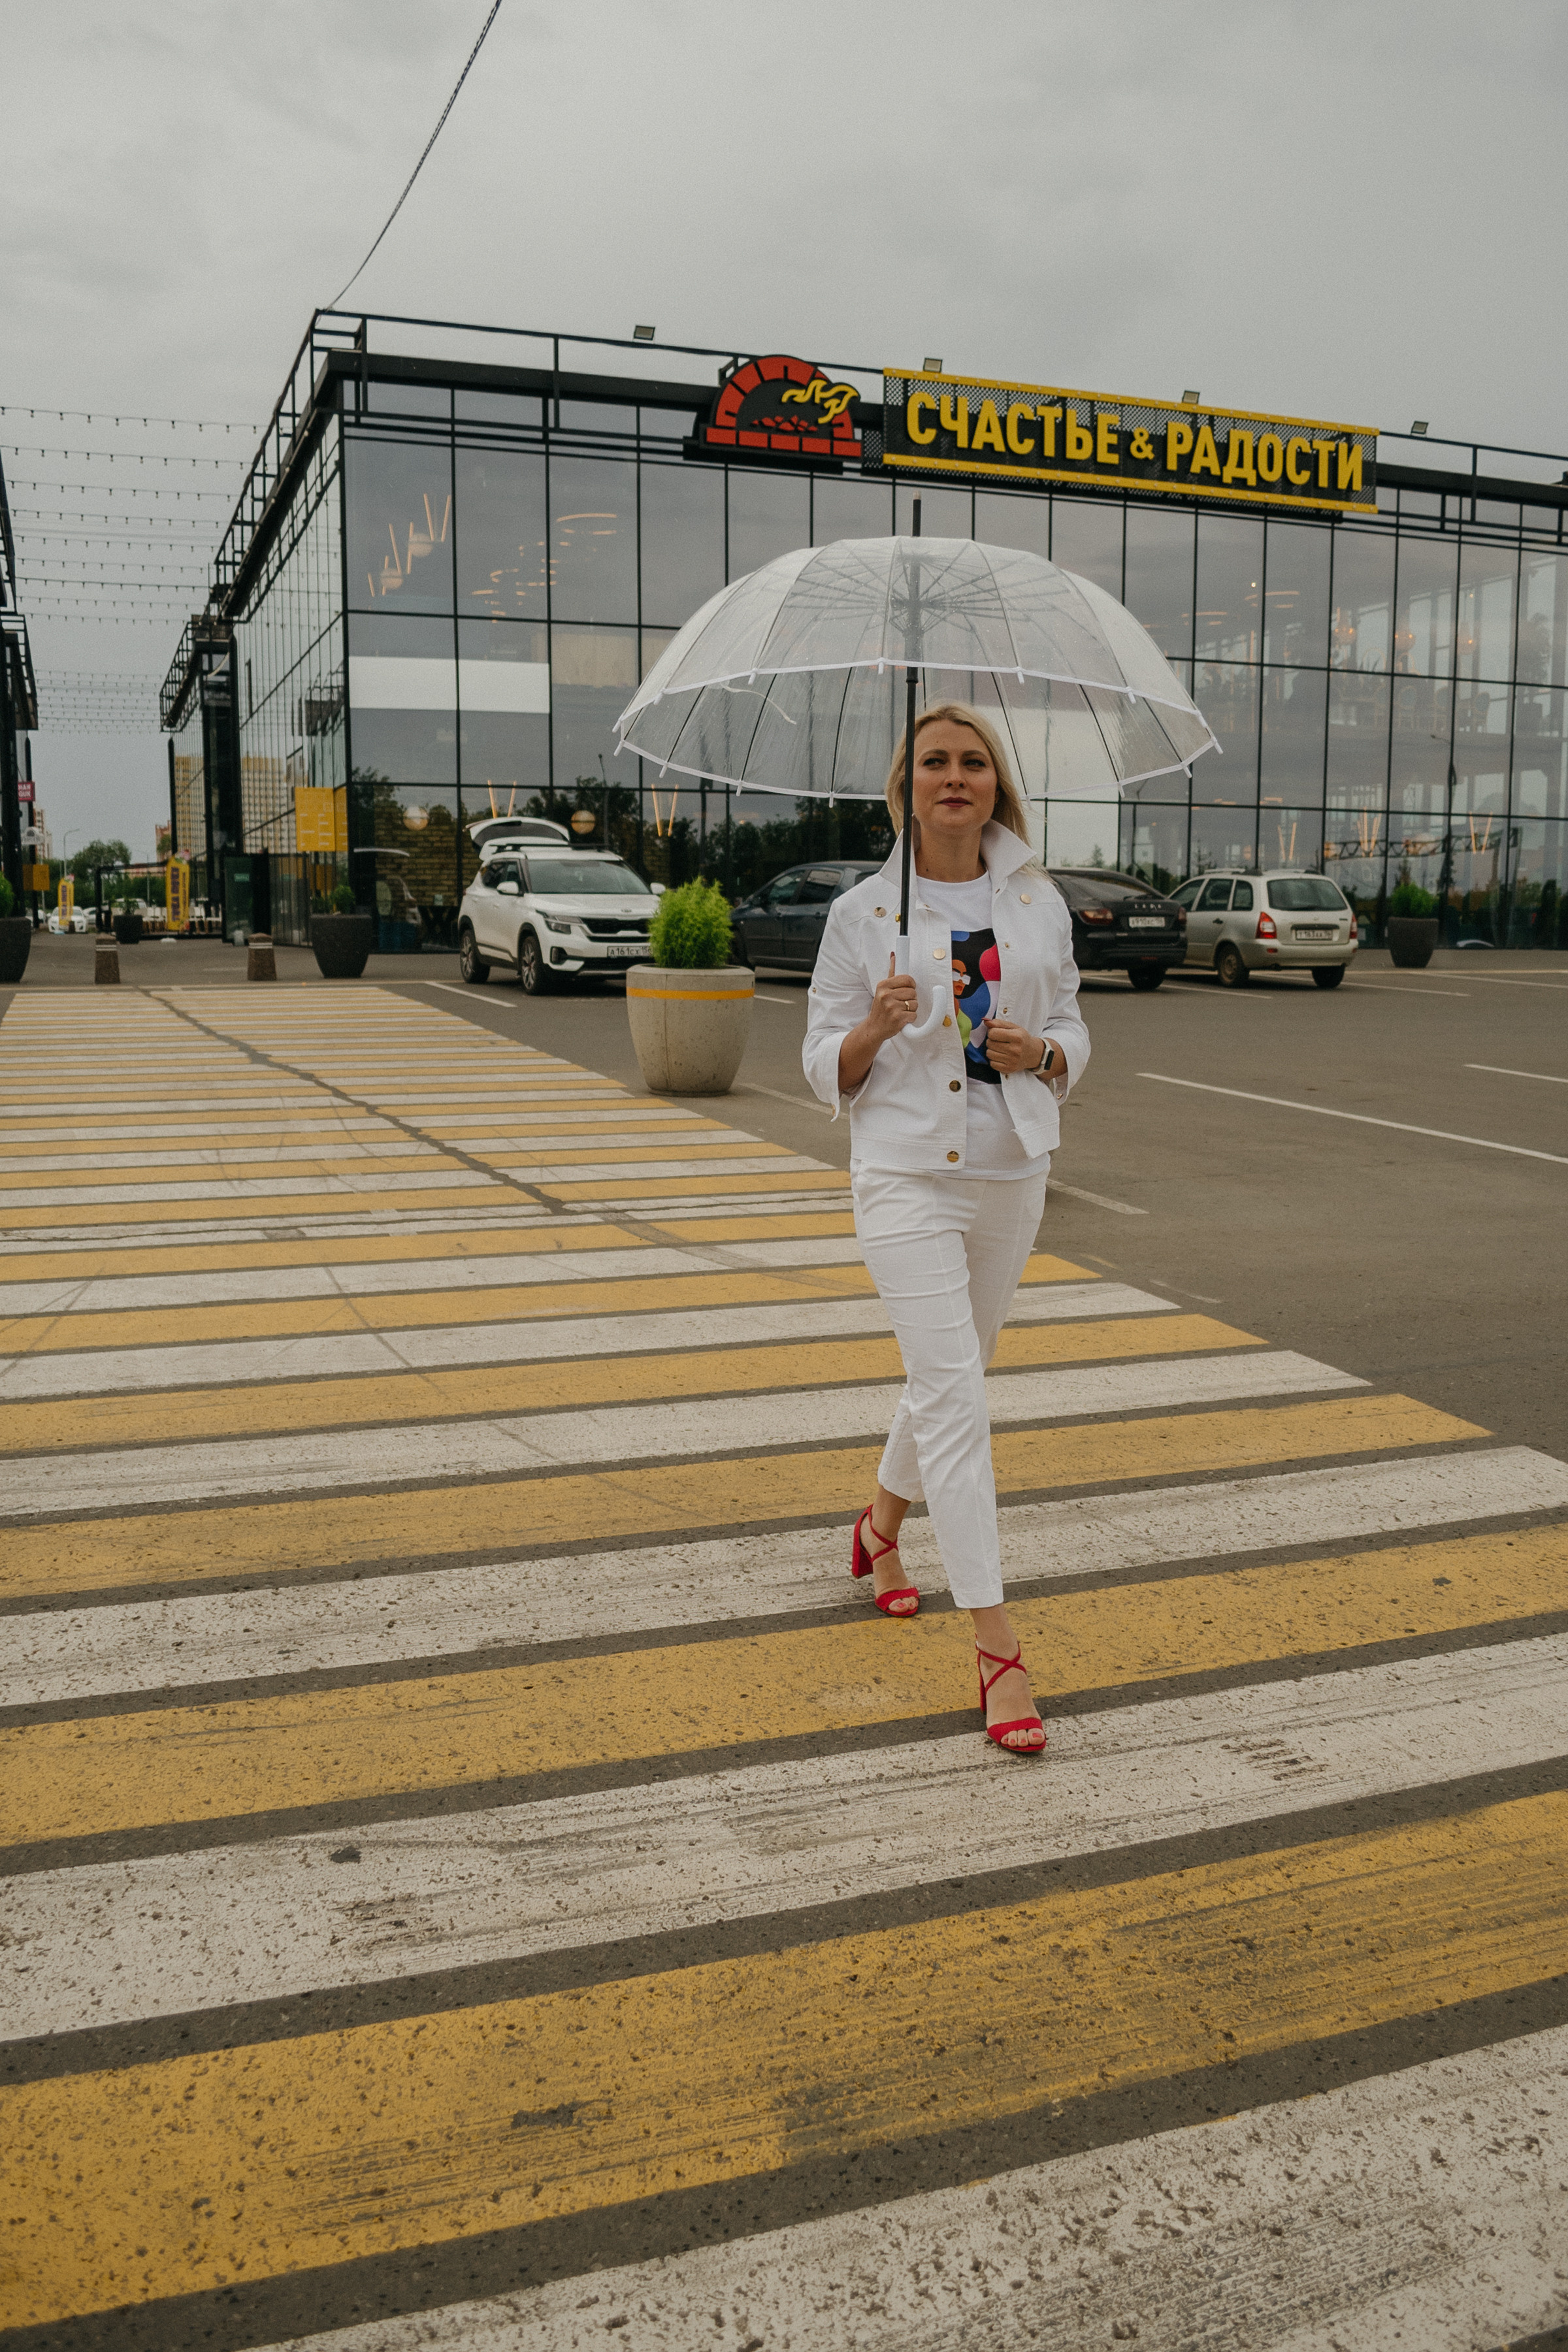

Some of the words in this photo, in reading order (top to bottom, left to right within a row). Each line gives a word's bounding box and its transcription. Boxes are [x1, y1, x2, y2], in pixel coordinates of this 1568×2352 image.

[907, 391, 1120, 465] СЧАСТЬЕ
[1130, 427, 1154, 460] &
[1166, 421, 1363, 491] РАДОСТИ
